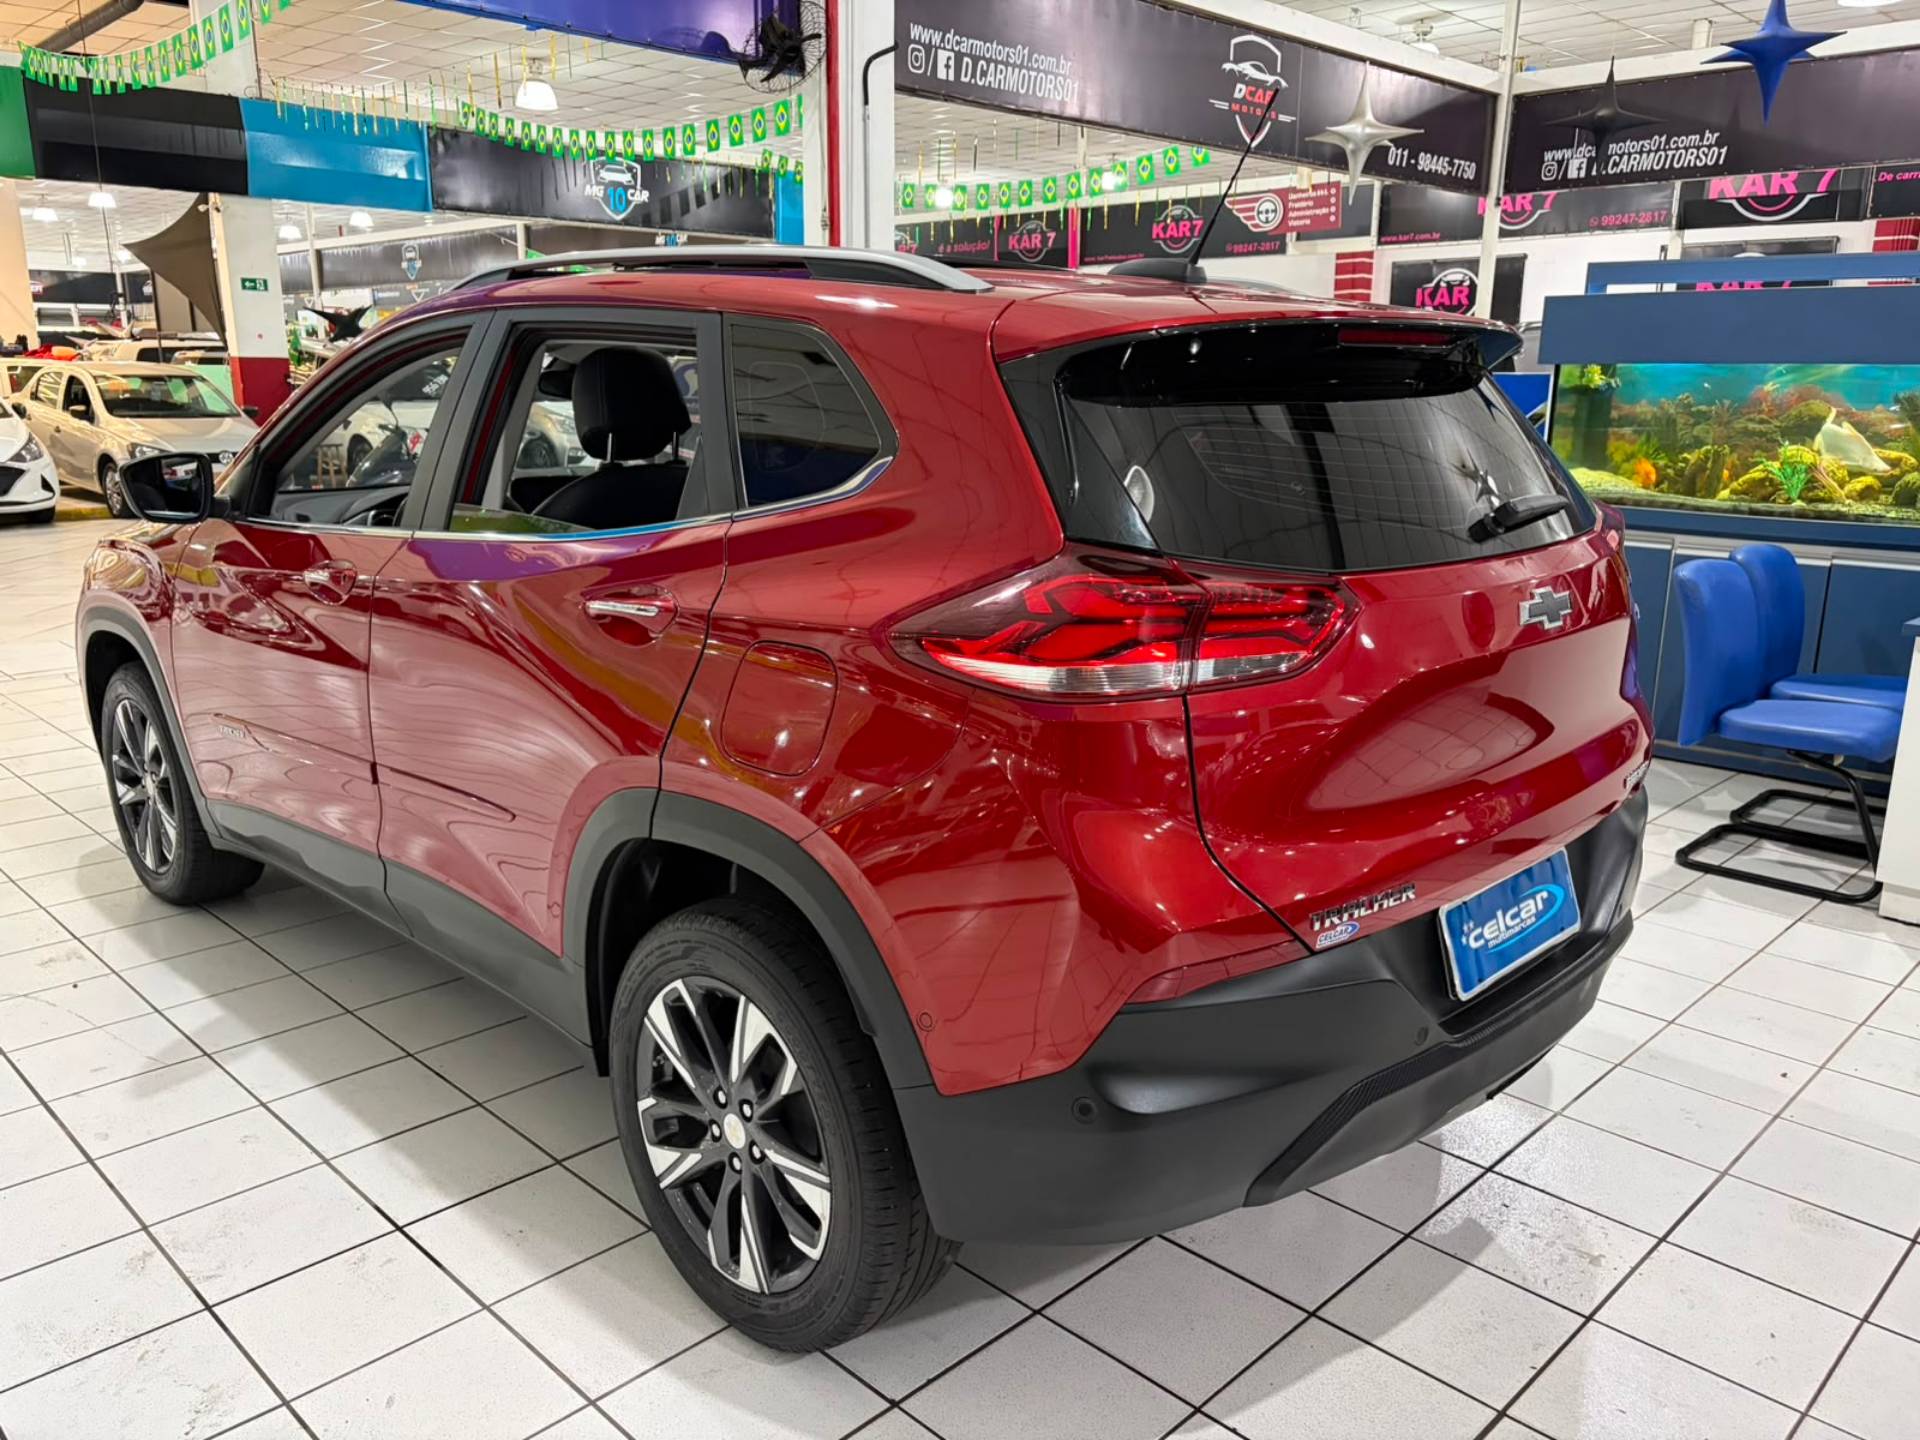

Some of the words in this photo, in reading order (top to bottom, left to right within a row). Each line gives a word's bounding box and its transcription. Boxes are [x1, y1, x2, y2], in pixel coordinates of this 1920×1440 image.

[910, 22, 1072, 75] www.dcarmotors01.com.br
[960, 56, 1080, 101] D.CARMOTORS01
[1387, 146, 1409, 168] 011
[1417, 151, 1477, 181] 98445-7750
[584, 183, 605, 198] MG
[607, 186, 628, 214] 10
[626, 188, 650, 204] CAR
[1708, 170, 1800, 200] KAR
[1008, 232, 1042, 250] KAR
[1046, 231, 1057, 248] 7
[1151, 220, 1191, 240] KAR
[1192, 219, 1205, 237] 7
[1415, 286, 1470, 308] KAR
[1309, 882, 1416, 932] TRACKER
[1319, 926, 1351, 943] CELCAR
